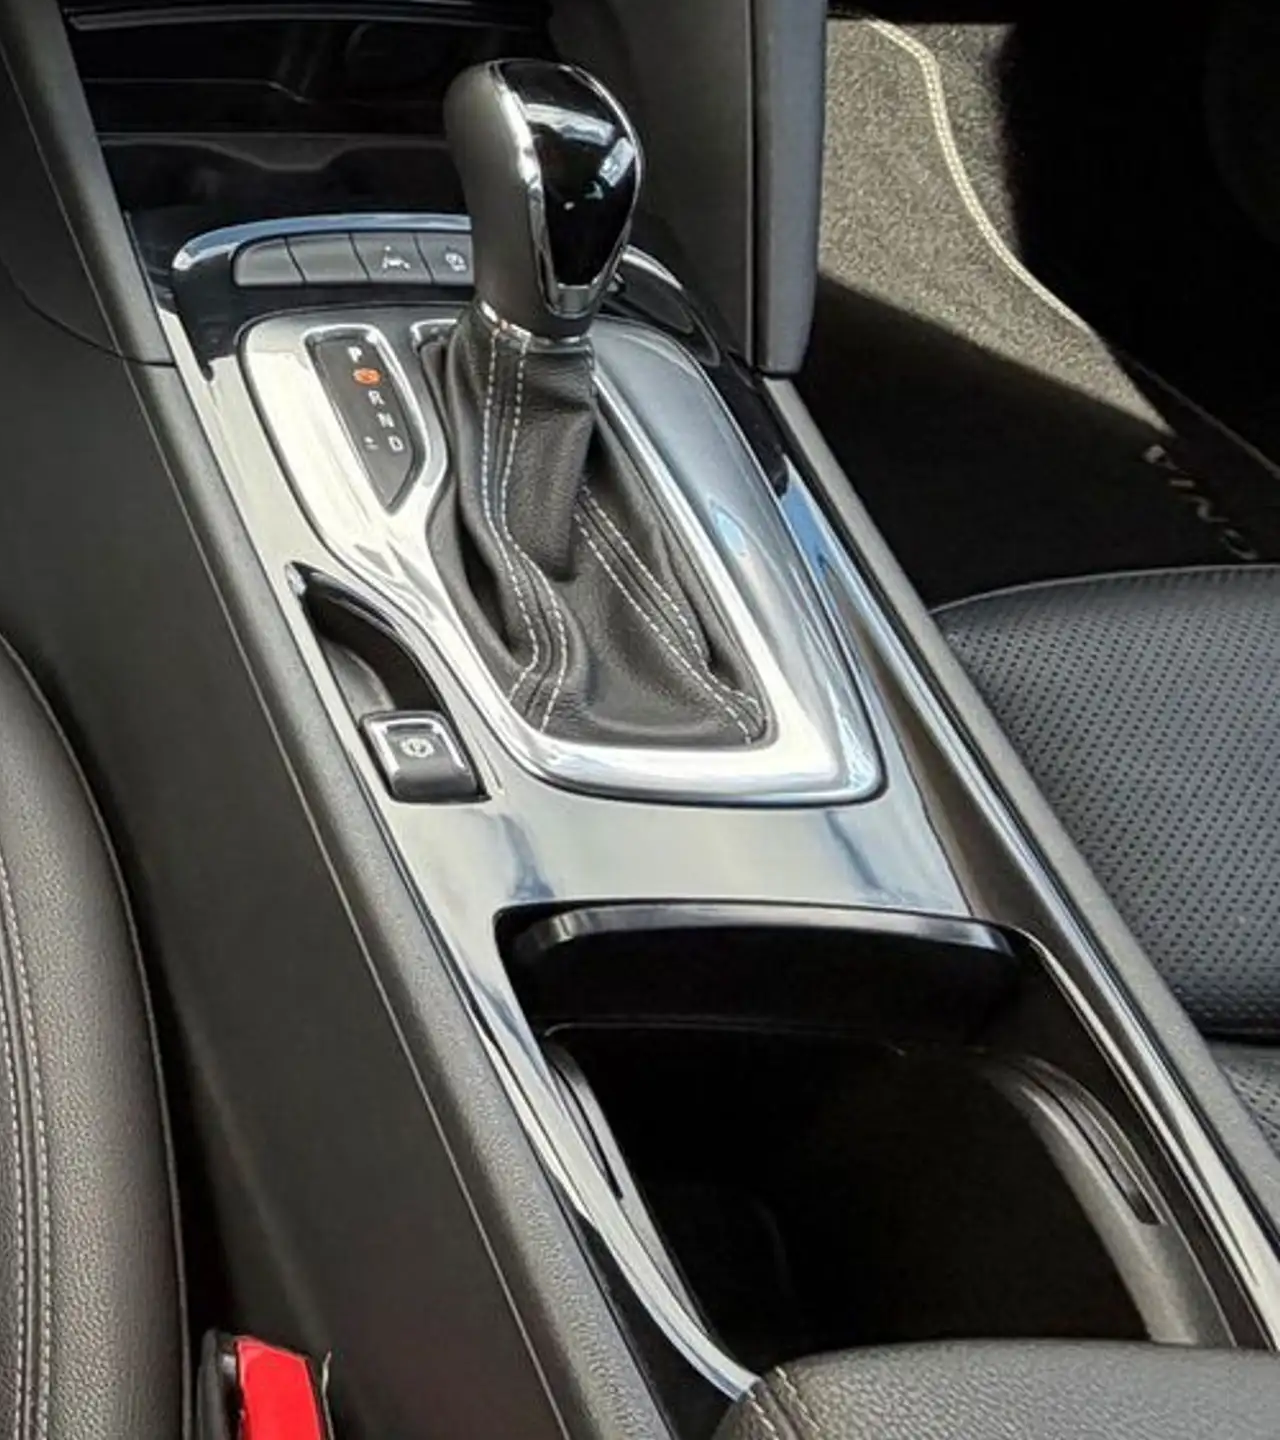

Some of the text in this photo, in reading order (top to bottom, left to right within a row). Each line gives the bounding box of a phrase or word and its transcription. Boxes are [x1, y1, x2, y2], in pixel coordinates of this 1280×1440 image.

[347, 346, 363, 363] P
[367, 389, 385, 406] R
[376, 412, 395, 428] N
[387, 435, 404, 453] D
